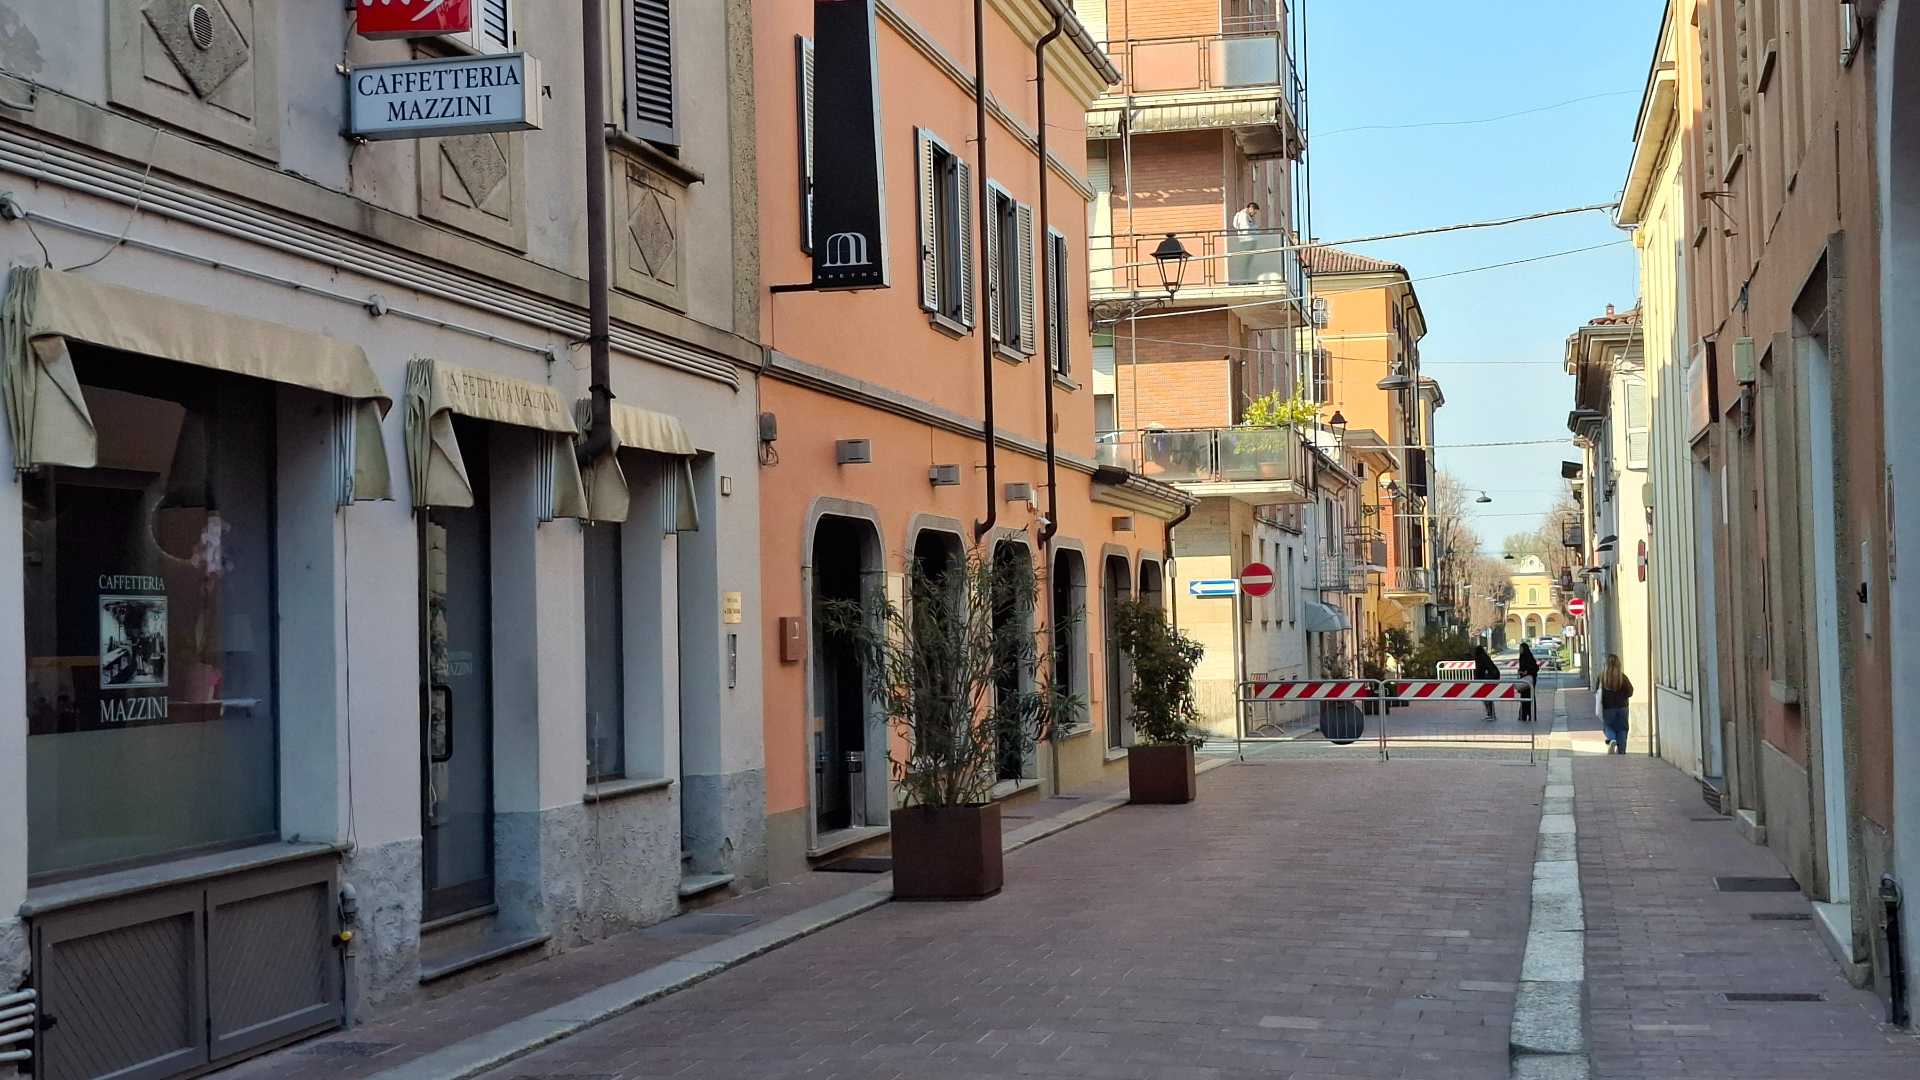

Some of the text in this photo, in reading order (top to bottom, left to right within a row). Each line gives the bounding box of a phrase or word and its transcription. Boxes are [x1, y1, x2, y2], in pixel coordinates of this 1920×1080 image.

[357, 64, 521, 97] CAFFETTERIA
[387, 94, 493, 122] MAZZINI
[98, 574, 166, 591] CAFFETTERIA
[99, 695, 169, 723] MAZZINI
